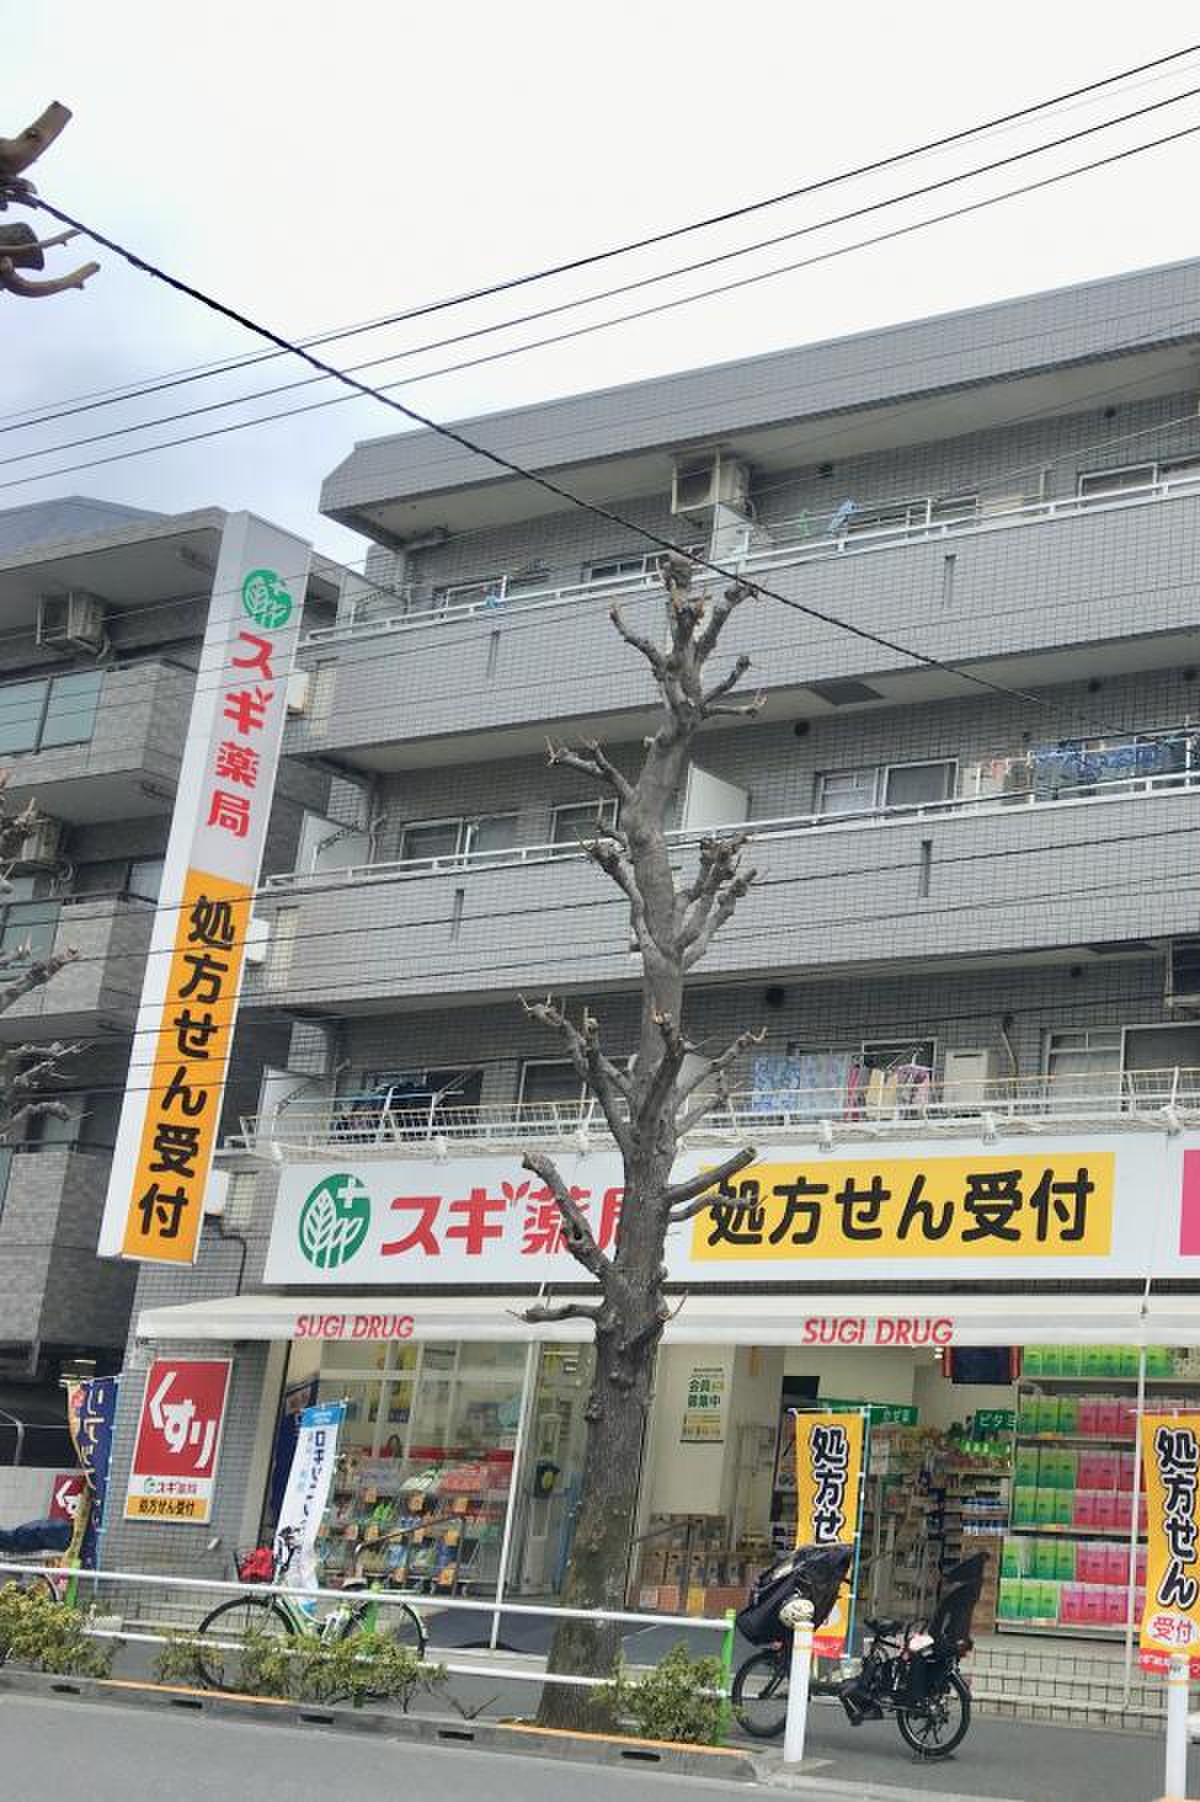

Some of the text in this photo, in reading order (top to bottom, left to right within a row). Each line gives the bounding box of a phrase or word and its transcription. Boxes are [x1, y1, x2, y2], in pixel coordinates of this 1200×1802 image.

[206, 630, 273, 840] スギ薬局
[138, 893, 236, 1240] 処方せん受付
[707, 1167, 1096, 1246] 処方せん受付
[295, 1315, 413, 1339] SUGI DRUG
[803, 1317, 954, 1345] SUGI DRUG
[149, 1371, 216, 1468] くすり
[809, 1423, 850, 1546] 処方せ
[1155, 1425, 1200, 1612] 処方せん
[1152, 1616, 1193, 1645] 受付
